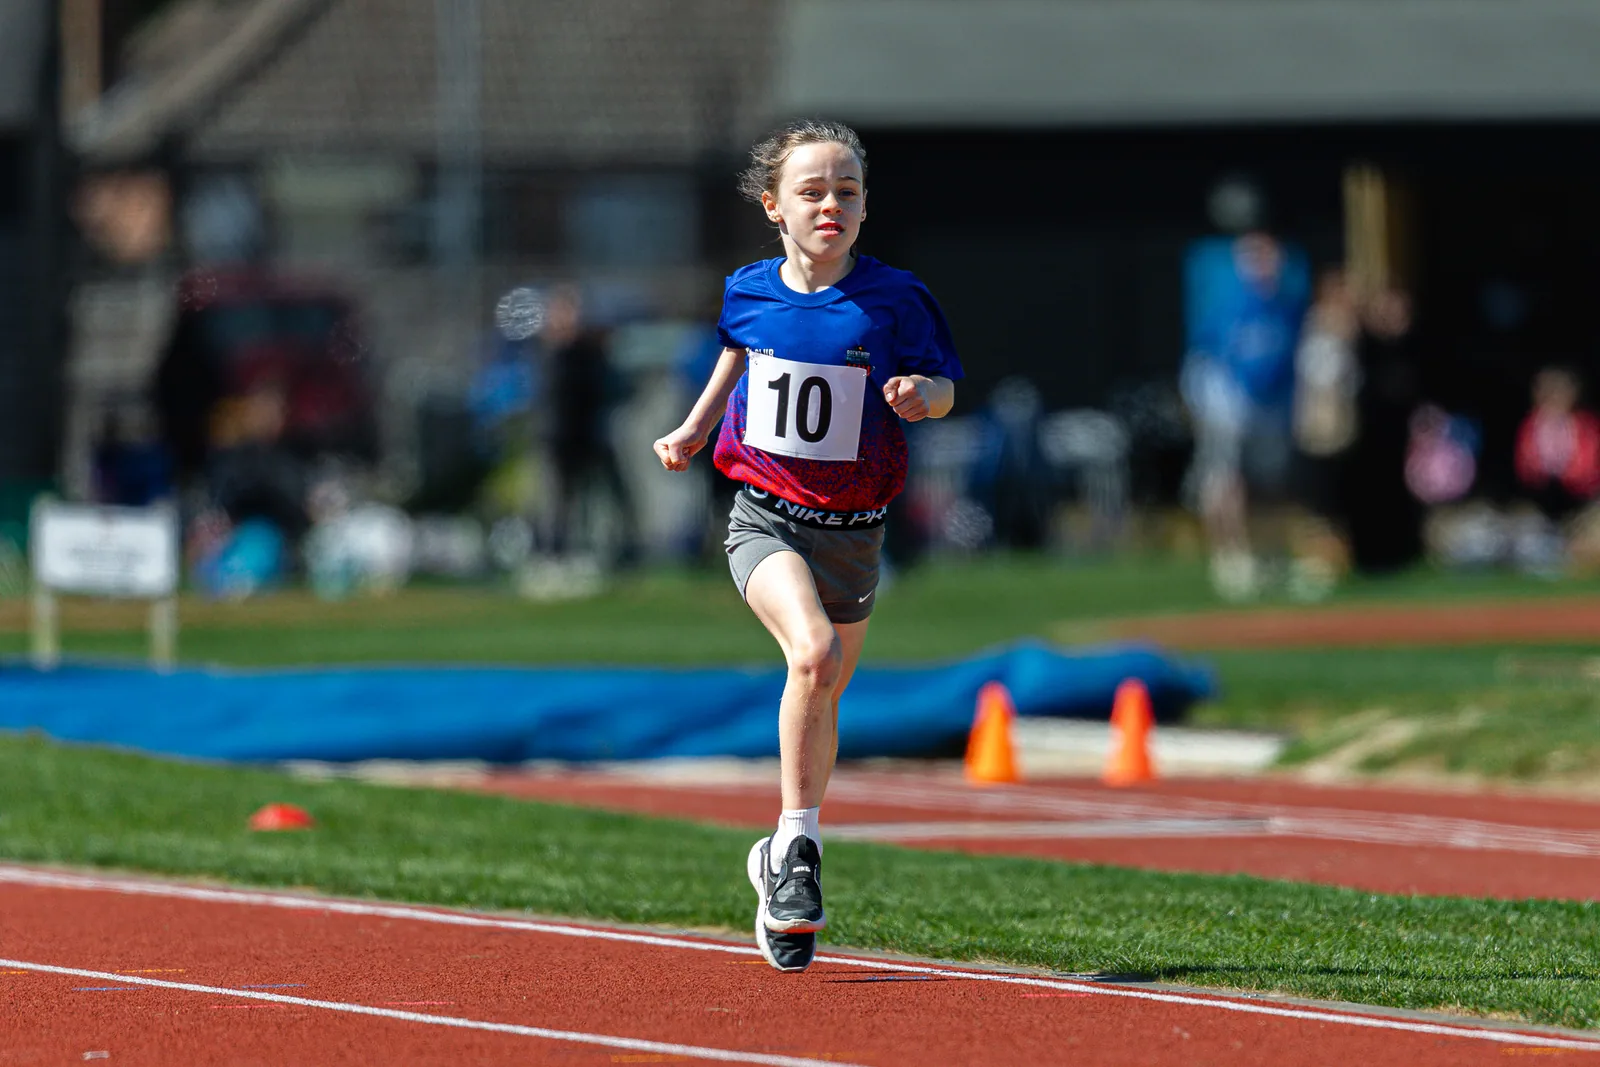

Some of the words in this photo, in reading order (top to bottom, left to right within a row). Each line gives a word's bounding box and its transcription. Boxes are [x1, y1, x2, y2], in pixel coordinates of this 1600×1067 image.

[768, 372, 832, 443] 10
[775, 498, 846, 525] NIKE
[848, 504, 887, 525] PR
